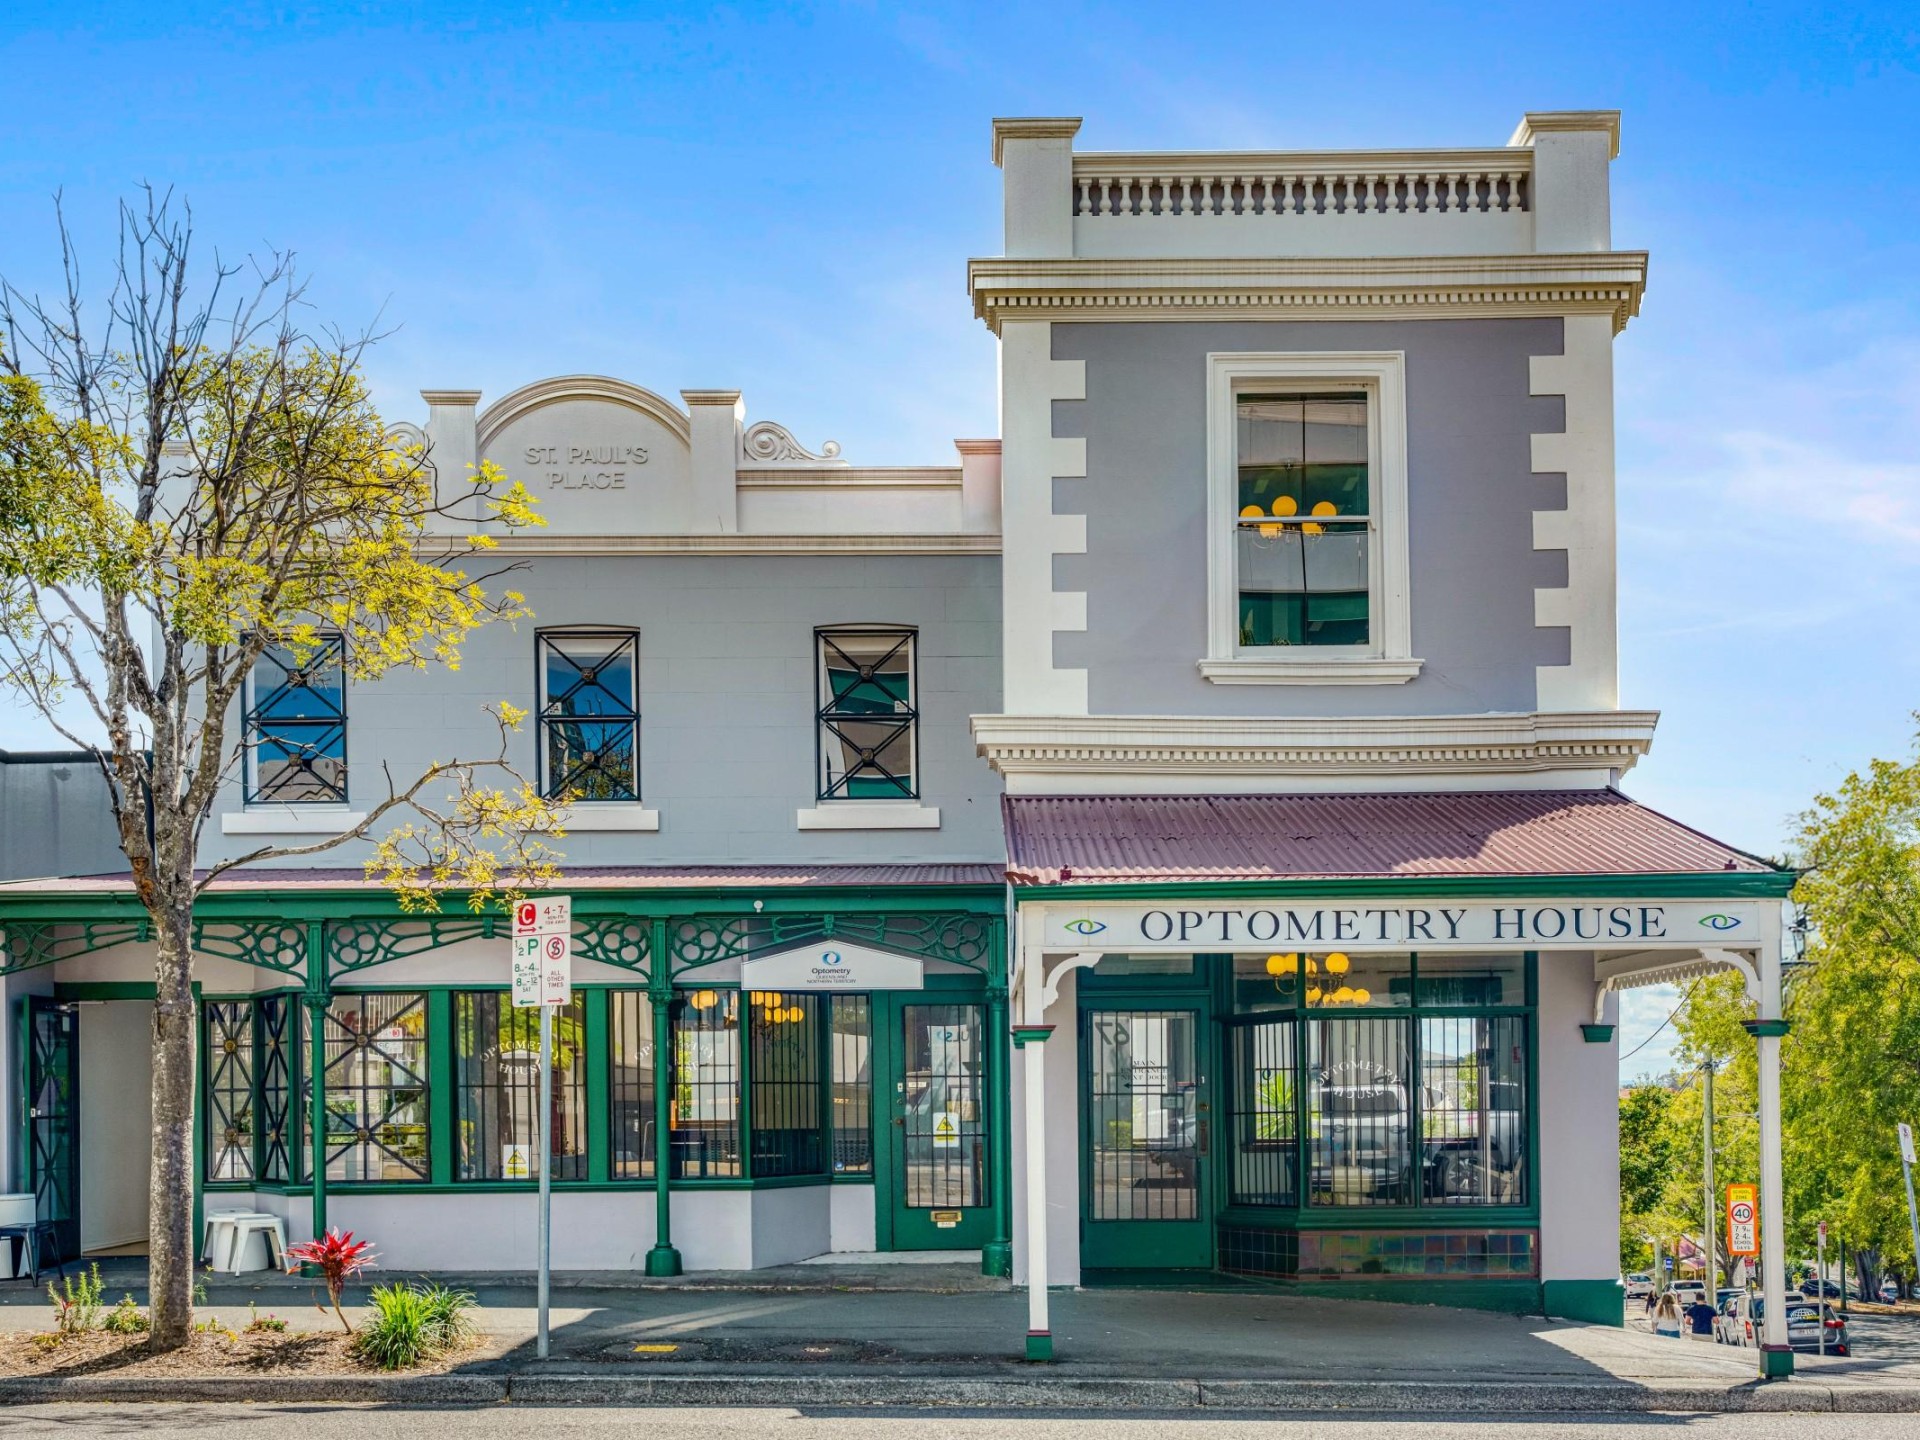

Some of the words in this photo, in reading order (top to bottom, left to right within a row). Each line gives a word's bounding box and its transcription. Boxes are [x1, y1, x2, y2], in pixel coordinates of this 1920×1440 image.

[525, 448, 557, 465] ST.
[567, 447, 649, 465] PAUL'S
[546, 472, 626, 490] PLACE
[521, 905, 533, 925] C
[1140, 909, 1468, 942] OPTOMETRY
[1492, 907, 1667, 940] HOUSE
[528, 939, 539, 955] P
[811, 967, 851, 976] Optometry
[1314, 1060, 1402, 1086] OPTOMETRY
[1734, 1208, 1750, 1219] 40
